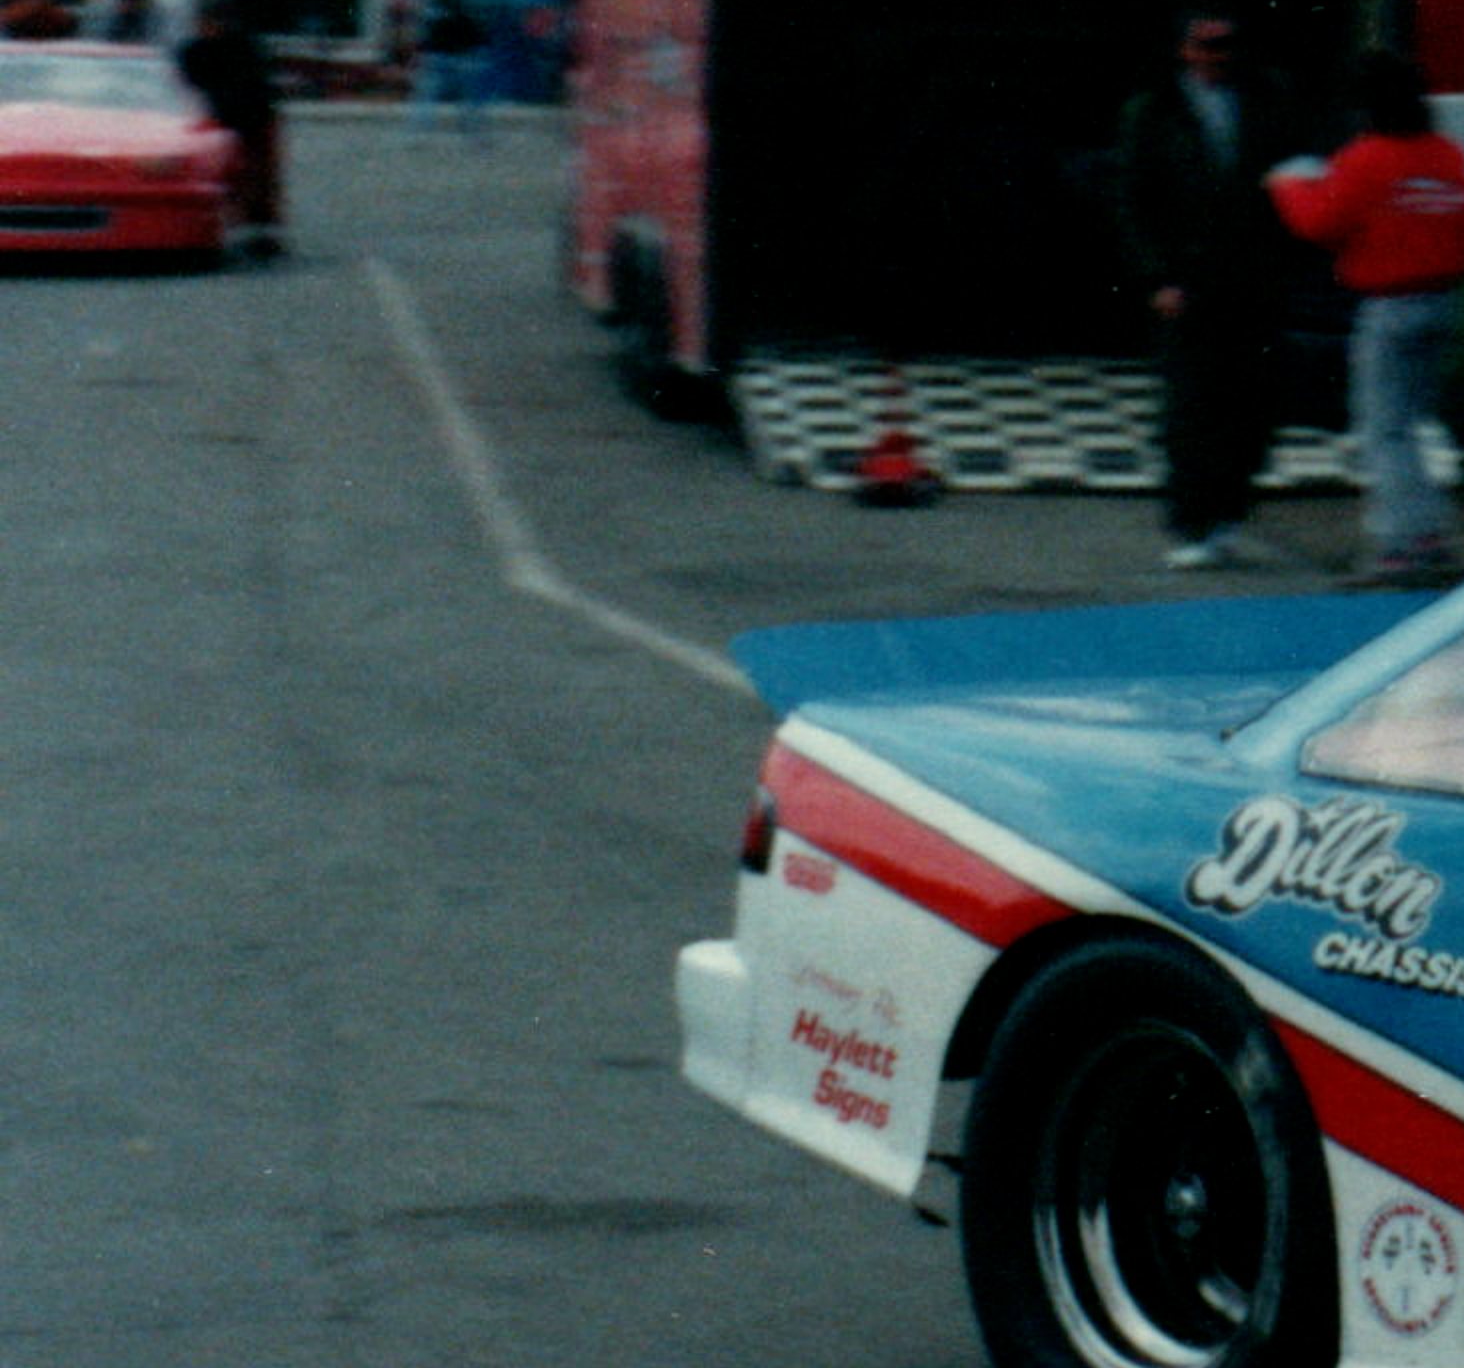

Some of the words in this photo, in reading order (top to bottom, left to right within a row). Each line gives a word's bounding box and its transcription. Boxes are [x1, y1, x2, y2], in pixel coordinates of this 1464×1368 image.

[1183, 793, 1444, 941] Dillon
[790, 1008, 897, 1079] Haylett
[813, 1067, 891, 1130] Signs
